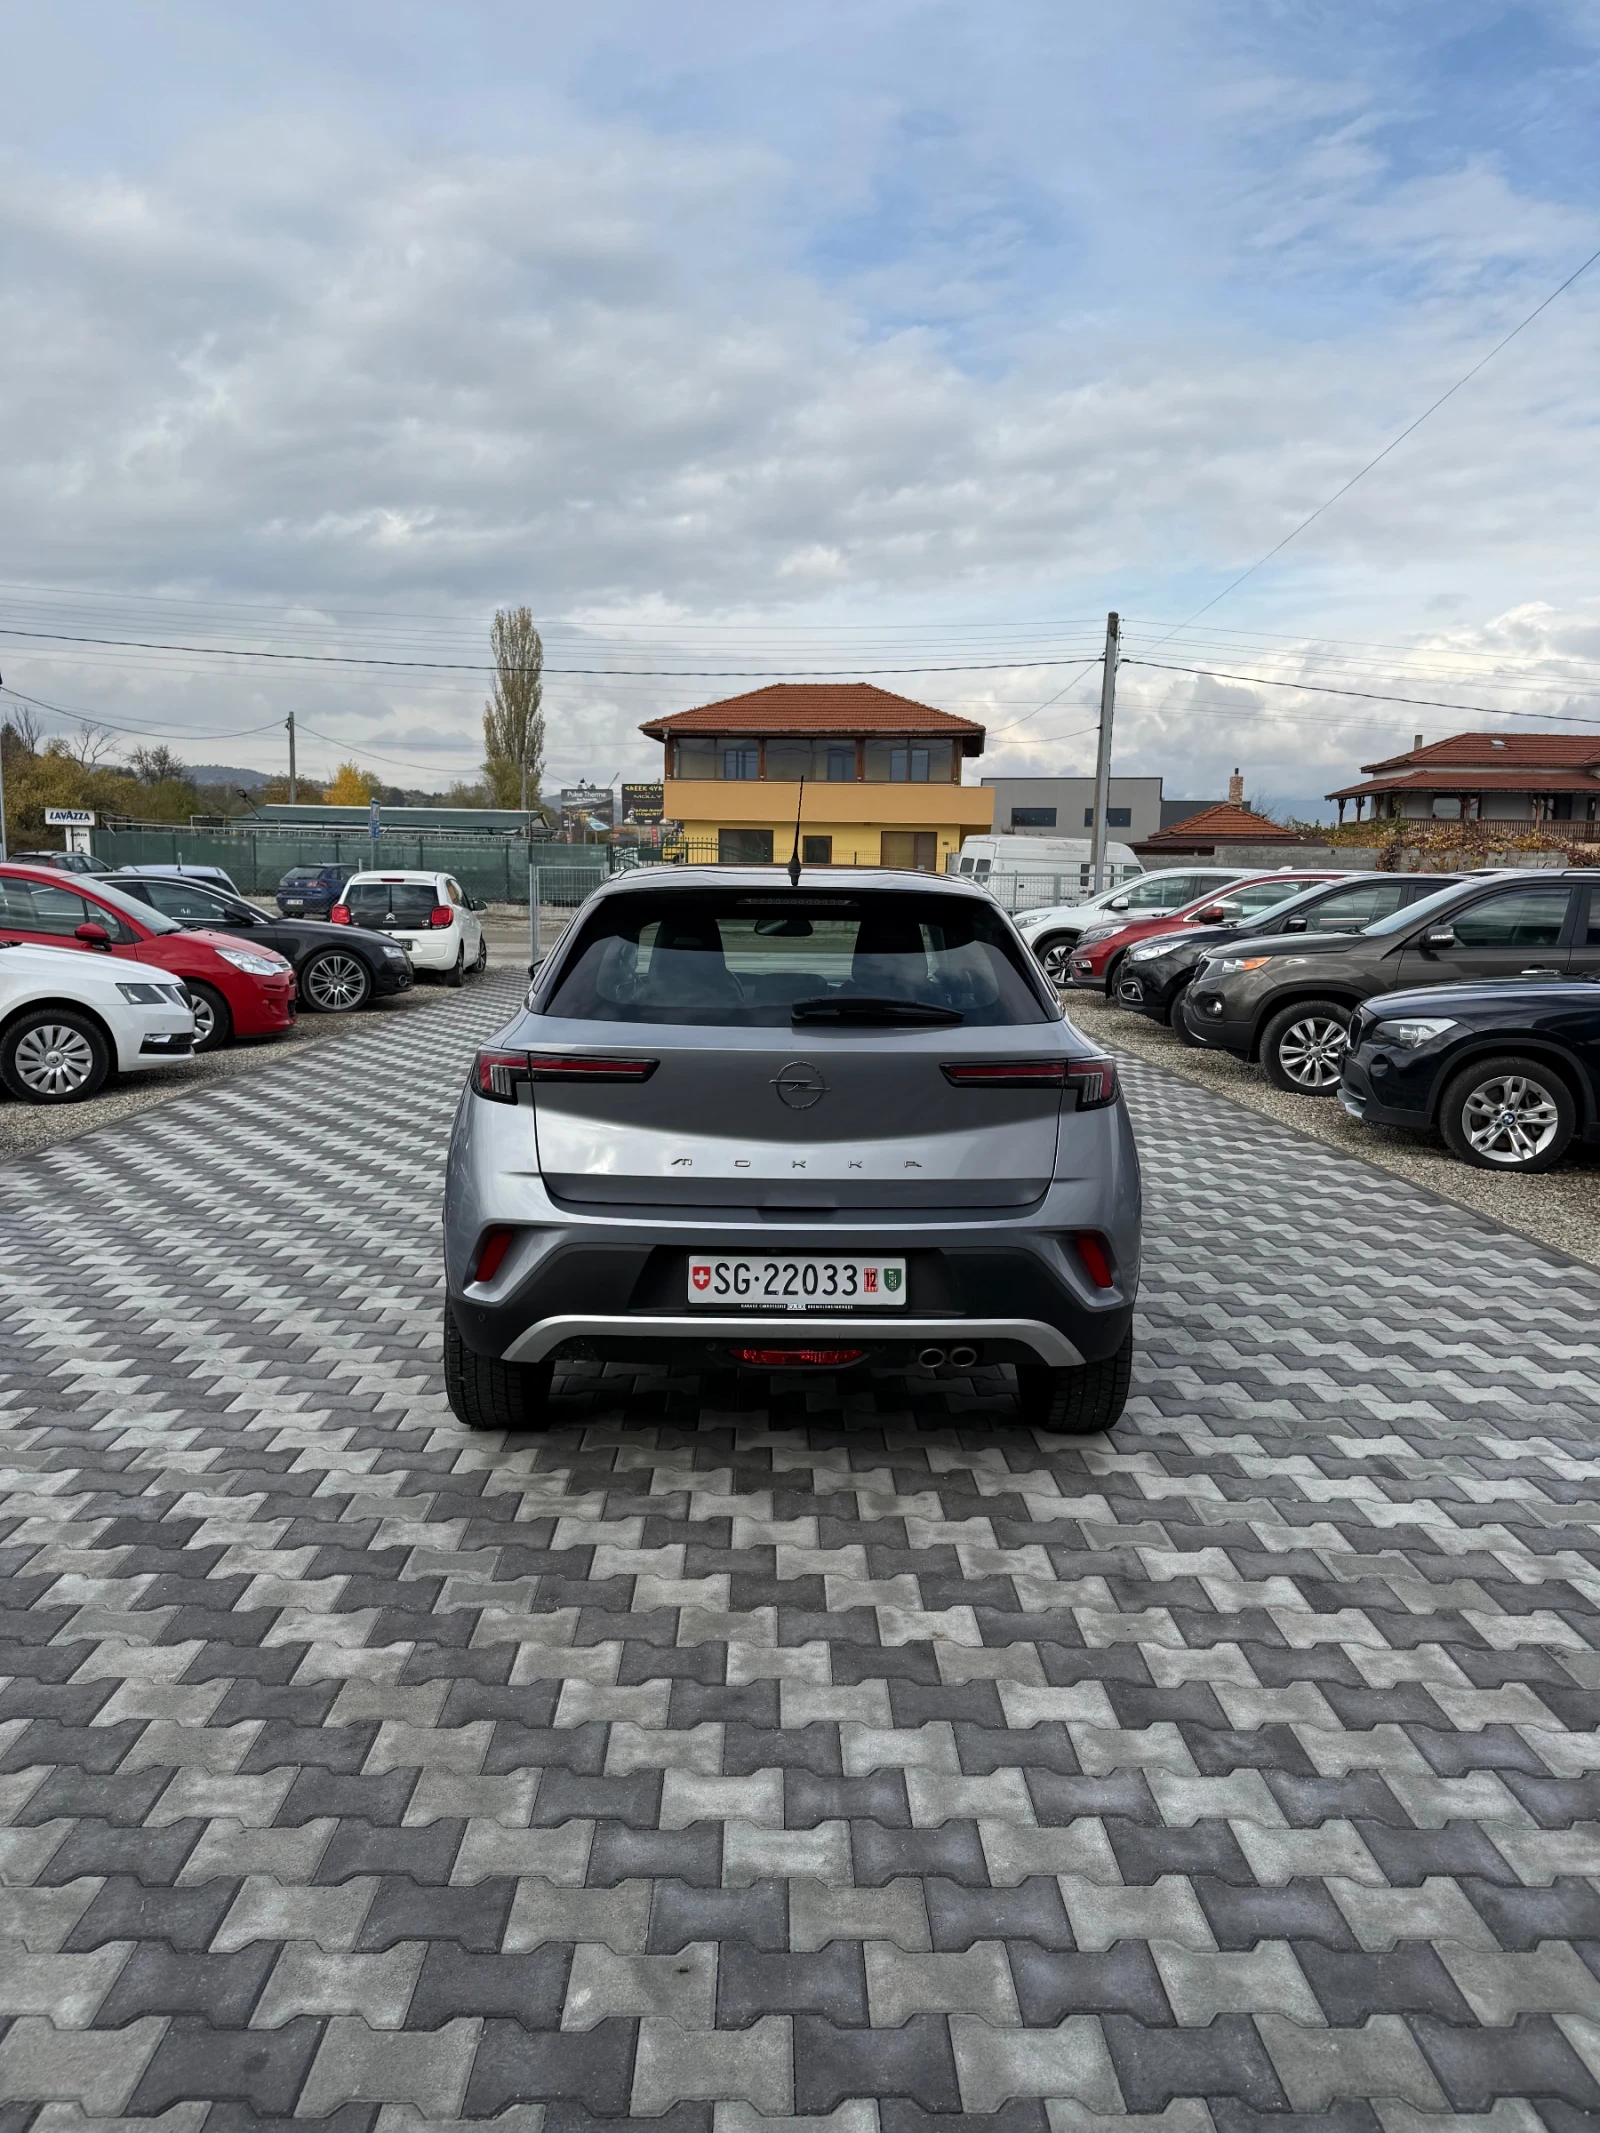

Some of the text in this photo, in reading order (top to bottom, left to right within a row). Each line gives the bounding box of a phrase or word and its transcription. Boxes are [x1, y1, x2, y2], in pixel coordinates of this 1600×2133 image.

[567, 790, 607, 798] Pulse Therme
[50, 810, 91, 821] LAVAZZA
[671, 1157, 923, 1169] MOKKA
[865, 1272, 877, 1288] 12
